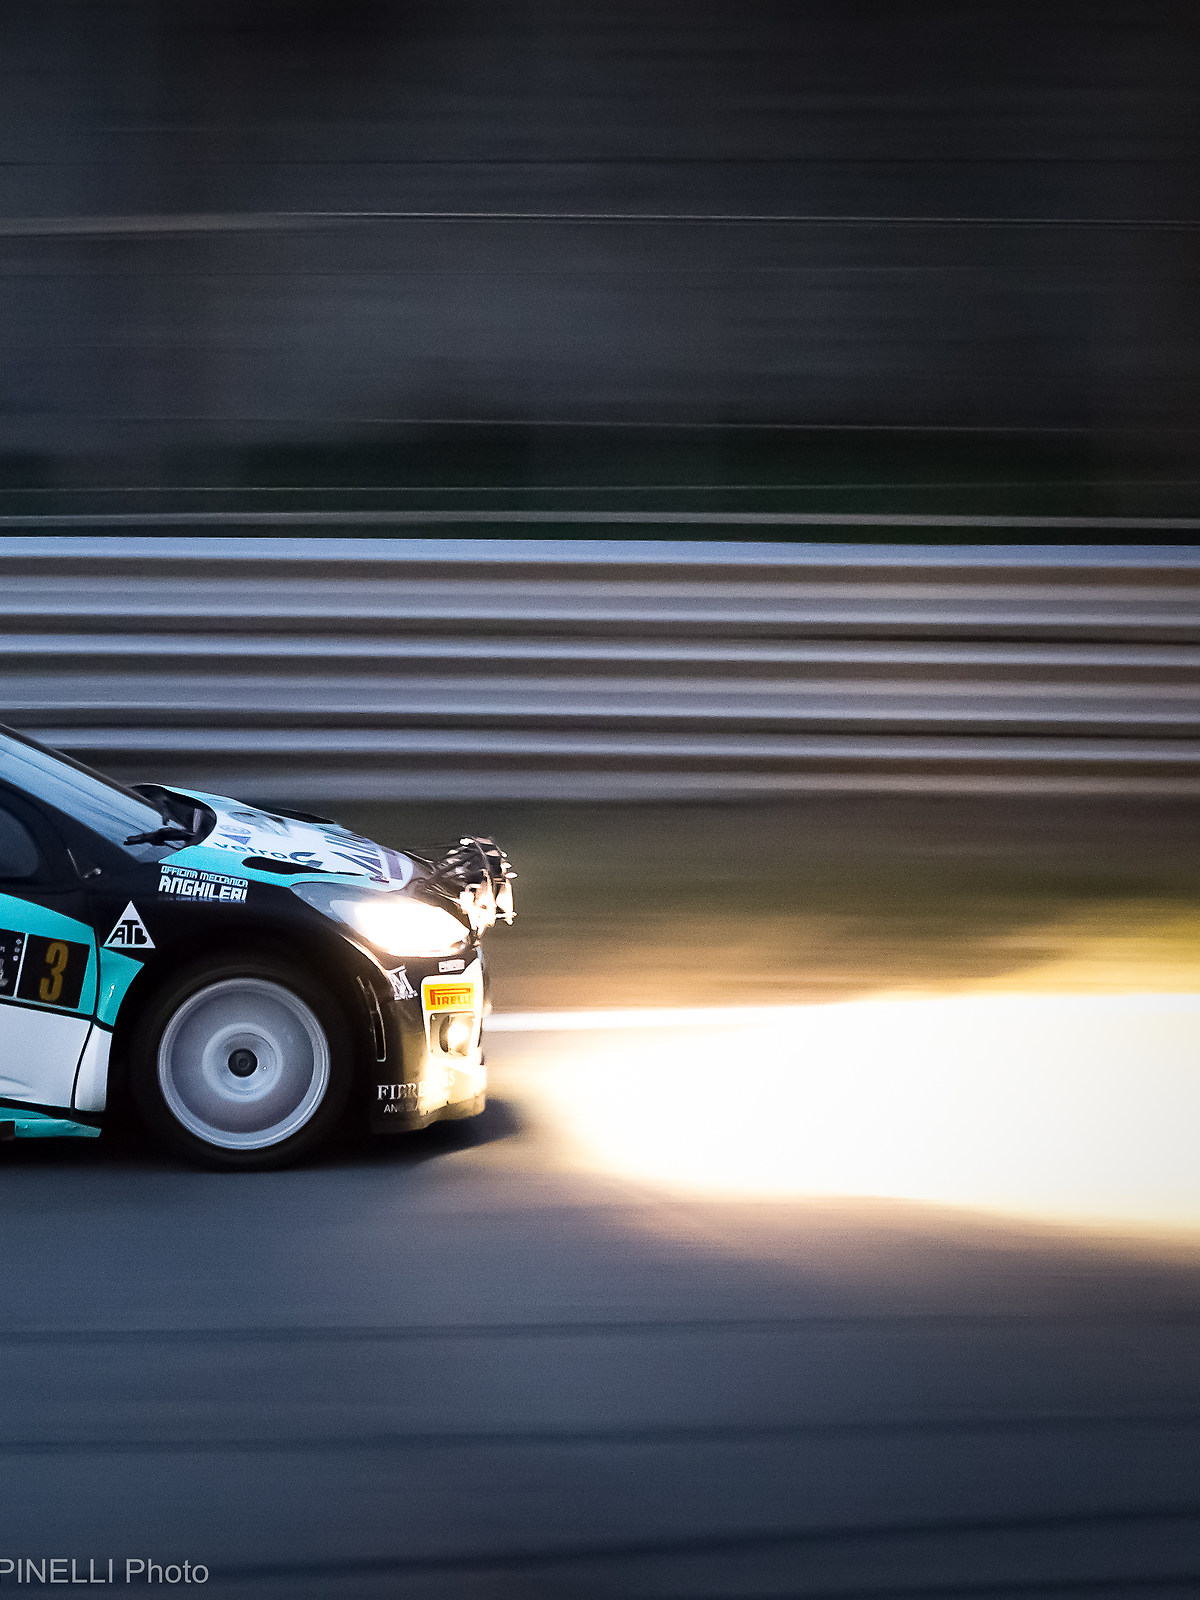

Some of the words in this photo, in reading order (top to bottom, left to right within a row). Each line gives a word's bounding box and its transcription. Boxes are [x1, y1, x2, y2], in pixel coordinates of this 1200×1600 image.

[158, 875, 248, 900] ANGHILERI
[108, 919, 149, 946] ATB
[39, 941, 70, 1002] 3
[429, 987, 471, 1006] PIRELLI
